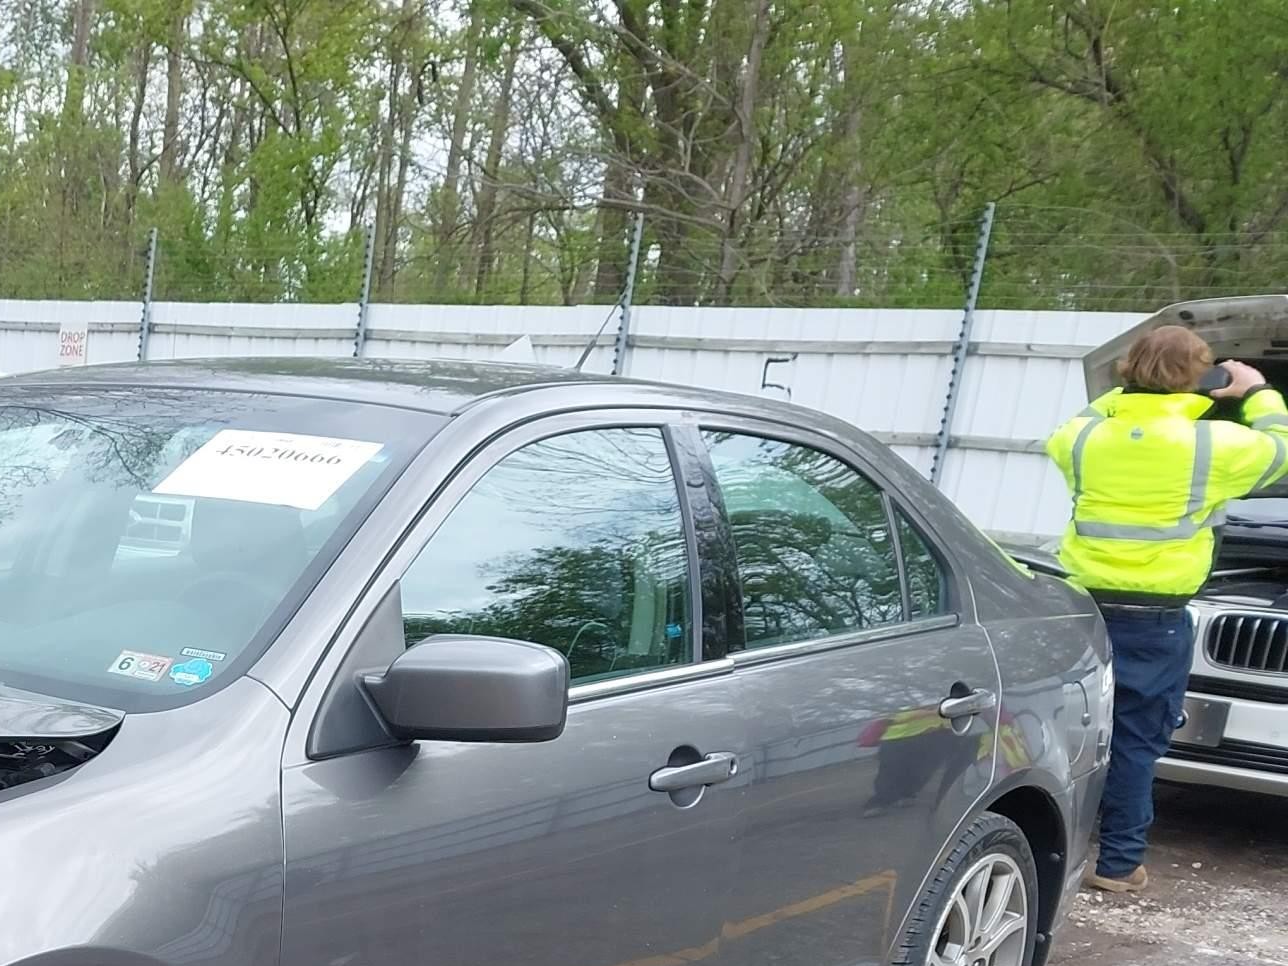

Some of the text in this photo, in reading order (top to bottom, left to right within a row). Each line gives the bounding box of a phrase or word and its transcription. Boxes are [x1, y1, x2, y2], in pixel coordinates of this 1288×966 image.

[60, 331, 86, 344] DROP
[59, 345, 84, 357] ZONE
[215, 443, 344, 466] 45020666
[118, 656, 167, 673] 6 21
